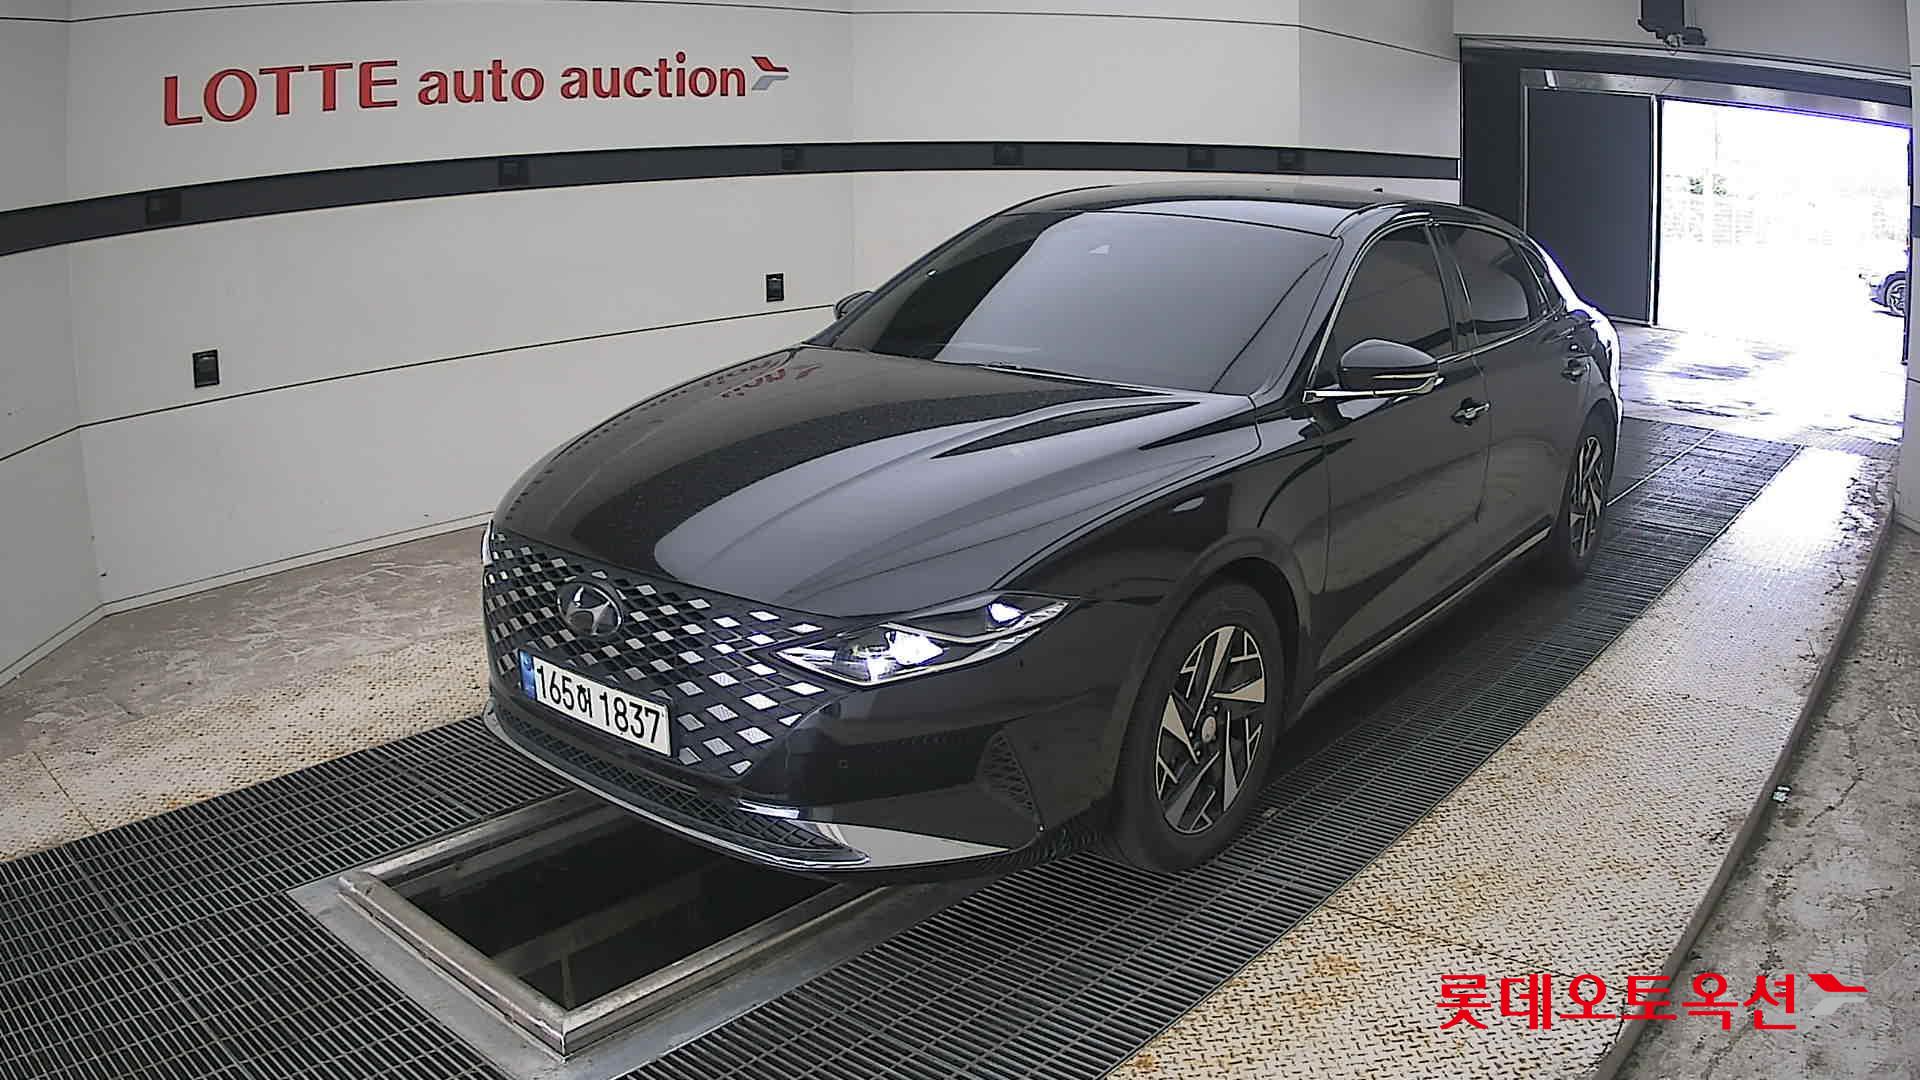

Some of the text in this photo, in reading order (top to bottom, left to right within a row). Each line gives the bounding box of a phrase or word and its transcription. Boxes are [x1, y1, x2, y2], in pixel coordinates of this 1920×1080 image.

[163, 52, 748, 127] LOTTE auto auction
[537, 665, 660, 743] 165허 1837
